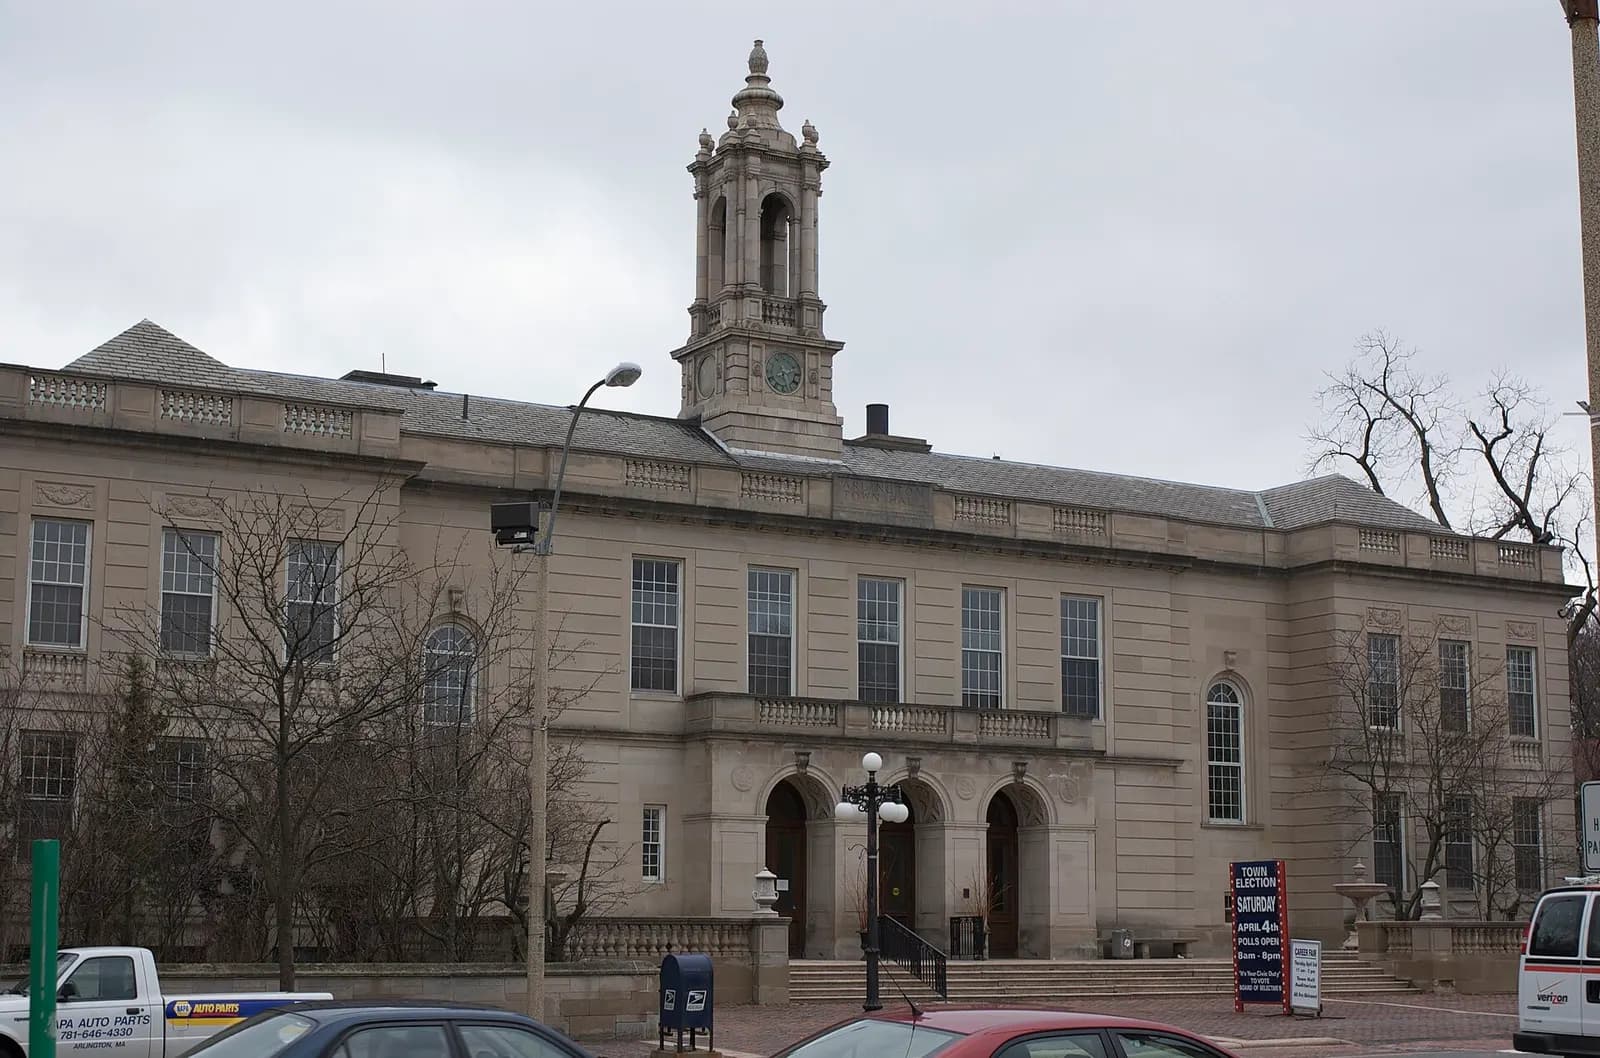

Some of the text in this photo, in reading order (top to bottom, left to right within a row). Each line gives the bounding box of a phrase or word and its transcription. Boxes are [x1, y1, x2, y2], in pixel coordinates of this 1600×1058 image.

[1241, 866, 1267, 877] TOWN
[1236, 877, 1276, 888] ELECTION
[1237, 896, 1276, 913] SATURDAY
[1238, 920, 1279, 933] APRIL 4th
[1238, 937, 1280, 946] POLLS OPEN
[1238, 951, 1256, 960] 8am
[1262, 951, 1280, 961] 8pm
[1537, 991, 1568, 1004] verizon
[193, 1004, 215, 1013] AUTO
[215, 1003, 239, 1013] PARTS
[78, 1017, 110, 1028] AUTO
[114, 1015, 151, 1026] PARTS
[60, 1027, 133, 1040] 781-646-4330
